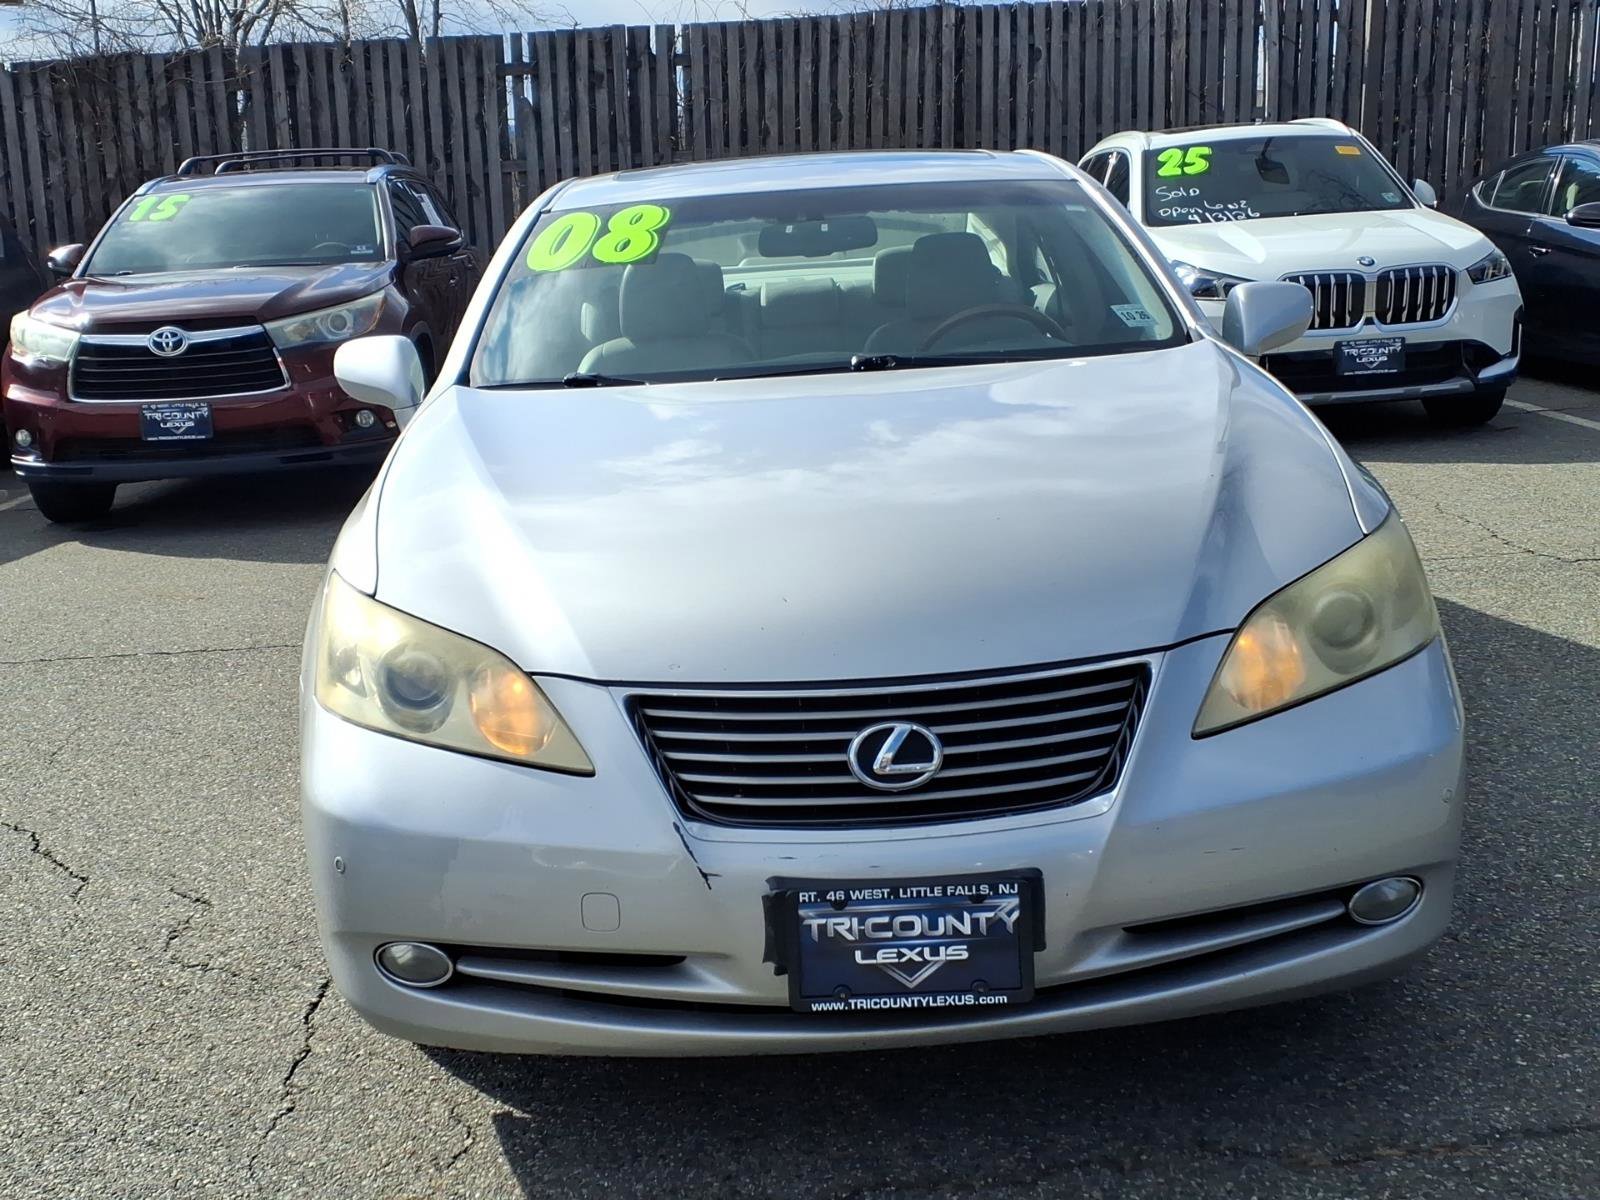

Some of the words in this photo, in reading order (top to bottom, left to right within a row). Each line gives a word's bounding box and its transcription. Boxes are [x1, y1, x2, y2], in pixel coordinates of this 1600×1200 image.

[1157, 146, 1212, 177] 25
[129, 194, 191, 221] 15
[526, 204, 671, 272] 08
[160, 420, 195, 428] LEXUS
[799, 891, 821, 903] RT.
[826, 890, 846, 901] 46
[850, 888, 894, 900] WEST,
[899, 886, 943, 899] LITTLE
[998, 882, 1019, 895] NJ
[854, 944, 969, 965] LEXUS
[811, 994, 1008, 1012] www.TRICOUNTYLEXUS.com
